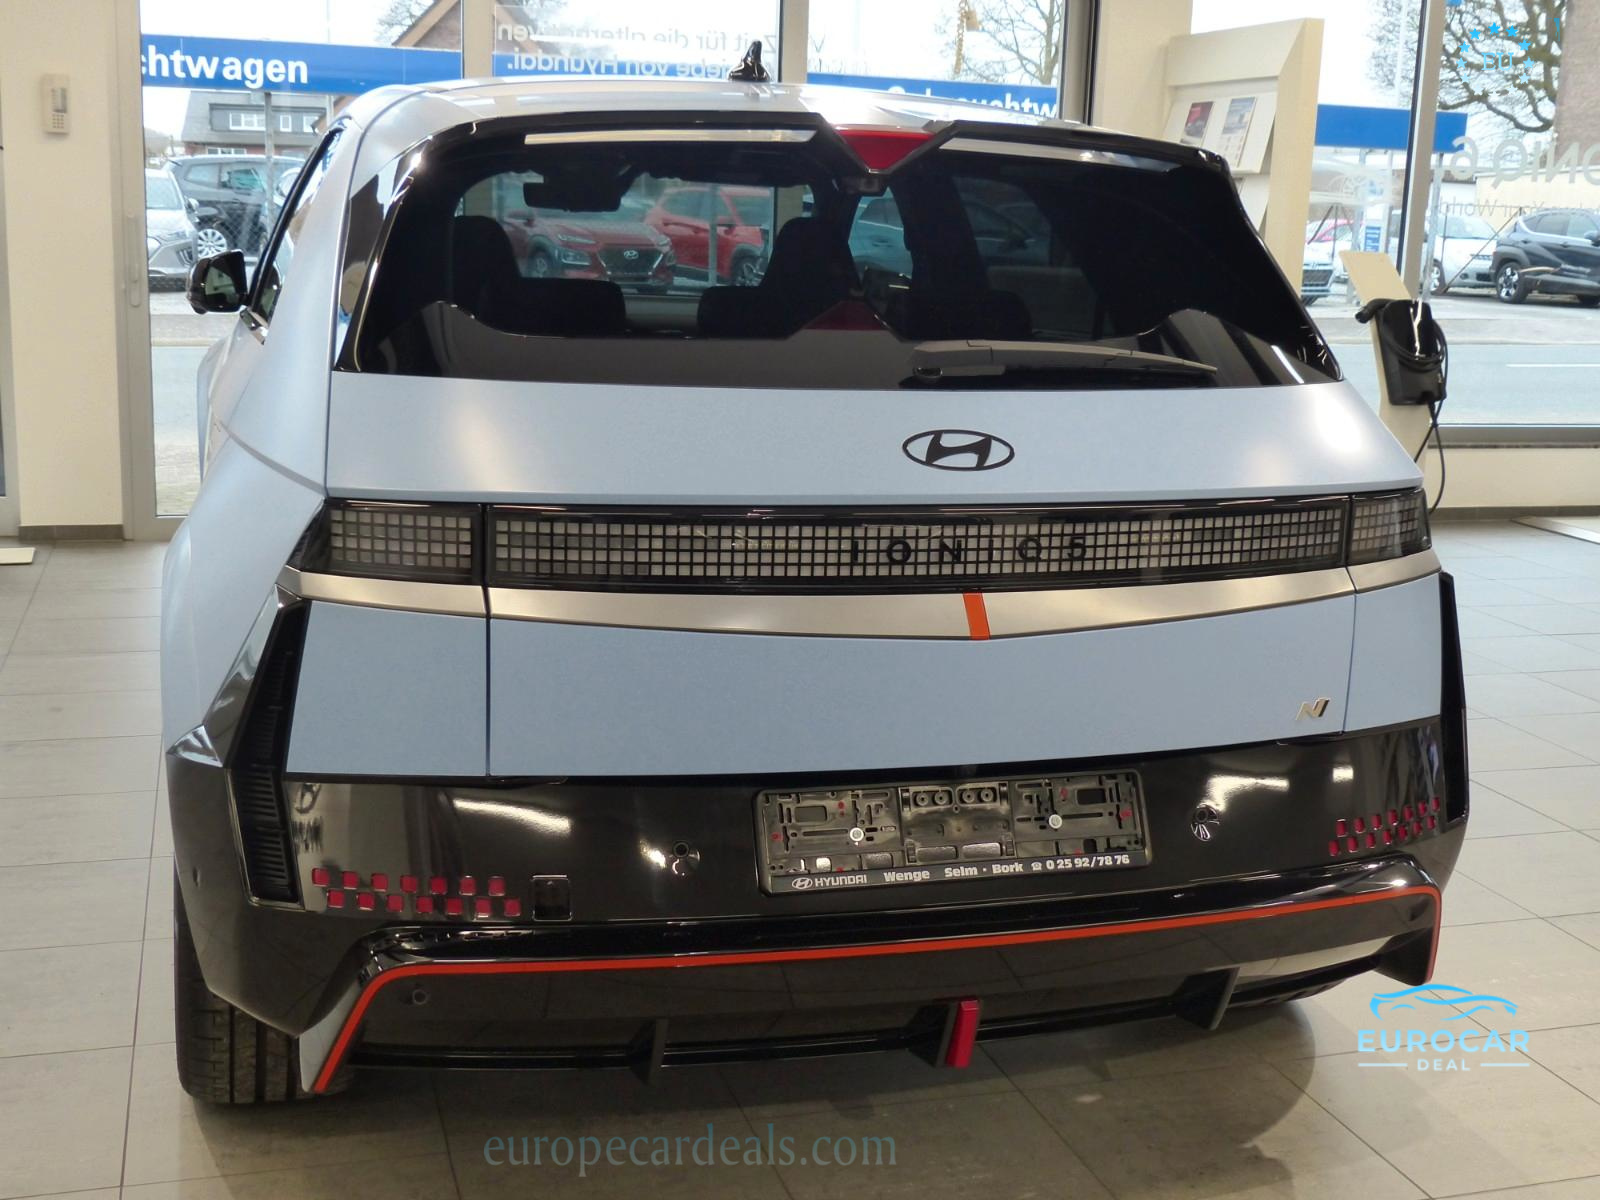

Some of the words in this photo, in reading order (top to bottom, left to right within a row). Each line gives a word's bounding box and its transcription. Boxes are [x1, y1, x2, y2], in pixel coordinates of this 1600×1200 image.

[852, 537, 1043, 565] IONIQ
[1067, 535, 1087, 562] 5
[814, 874, 867, 887] HYUNDAI
[883, 869, 930, 882] Wenge
[944, 865, 978, 878] Selm
[991, 862, 1024, 874] Bork
